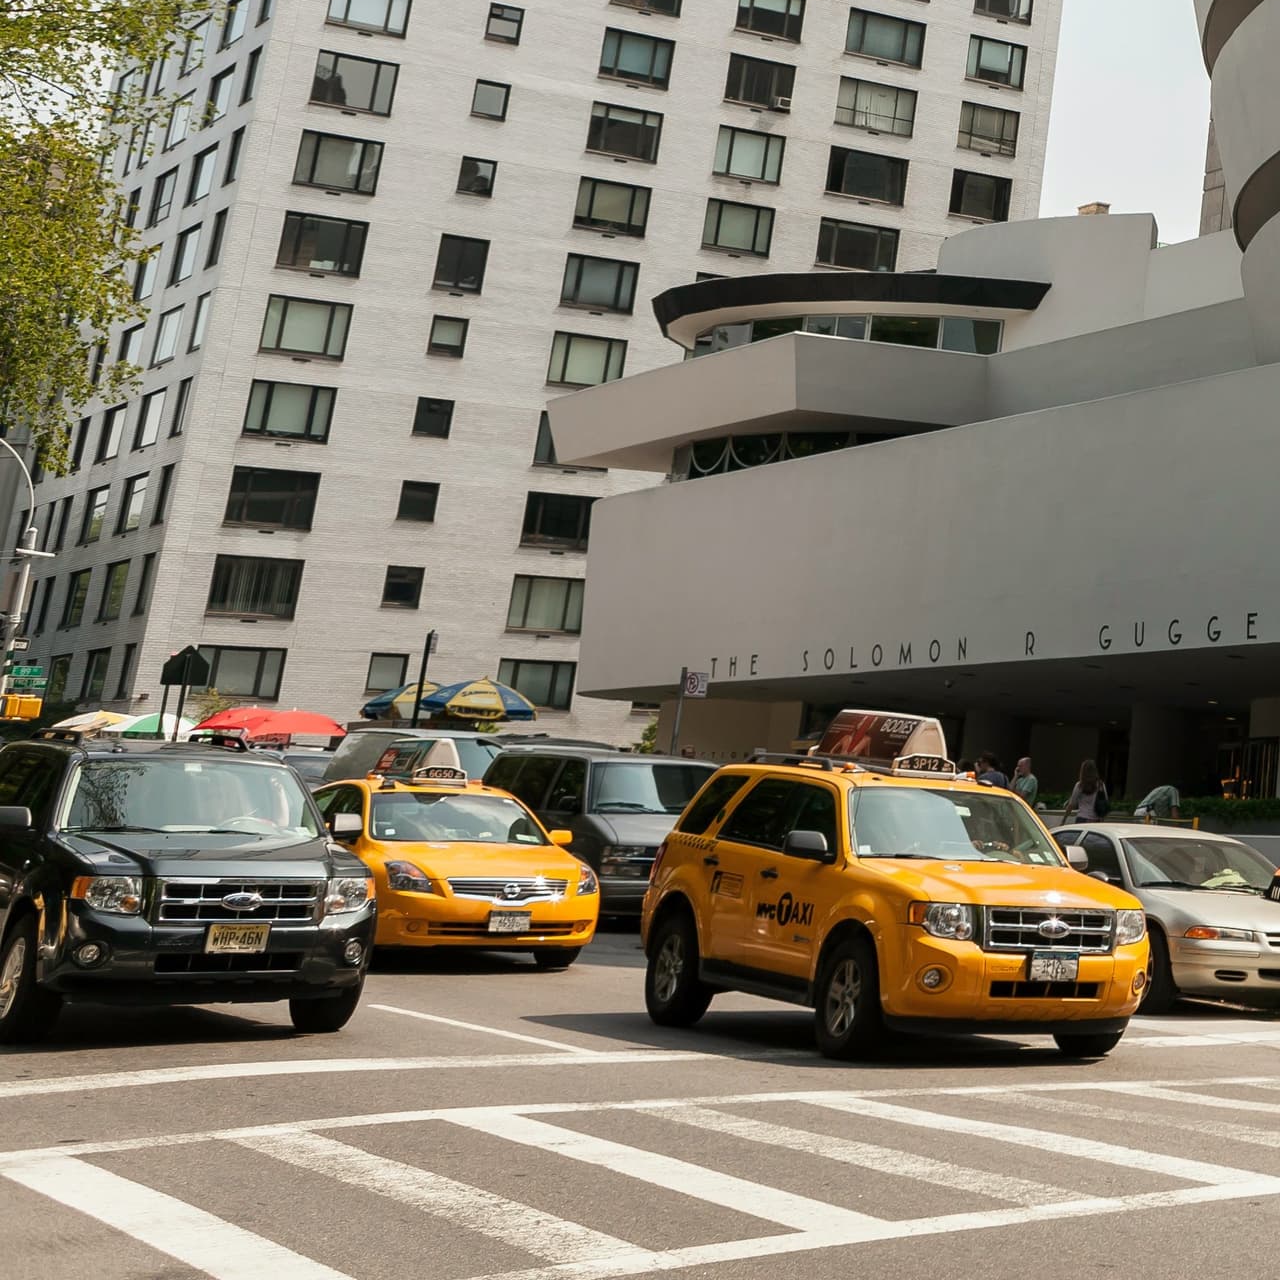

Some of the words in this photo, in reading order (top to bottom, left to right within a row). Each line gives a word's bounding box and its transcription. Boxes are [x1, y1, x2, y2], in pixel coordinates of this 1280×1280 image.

[710, 653, 759, 678] THE
[803, 637, 968, 673] SOLOMON
[1025, 632, 1036, 656] R
[880, 719, 918, 735] BODIES
[913, 758, 939, 771] 3P12
[429, 769, 454, 778] 6G50
